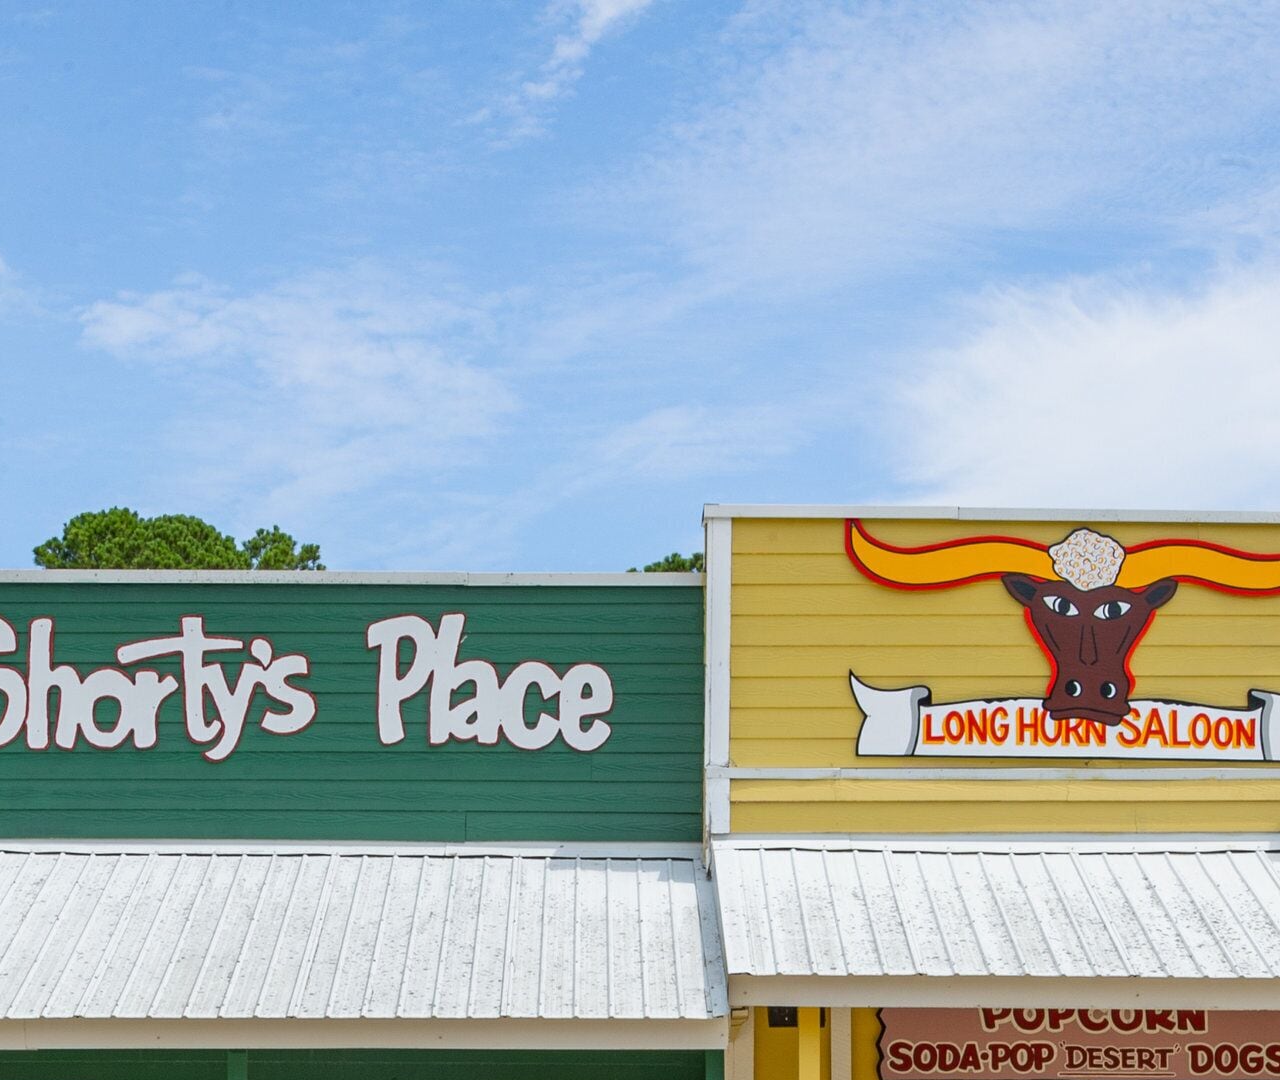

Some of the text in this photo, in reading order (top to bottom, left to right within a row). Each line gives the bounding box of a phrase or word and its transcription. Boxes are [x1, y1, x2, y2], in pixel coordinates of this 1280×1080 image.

[367, 612, 614, 752] Place
[923, 706, 1256, 749] LONG HORN SALOON
[980, 1008, 1208, 1032] POPCORN
